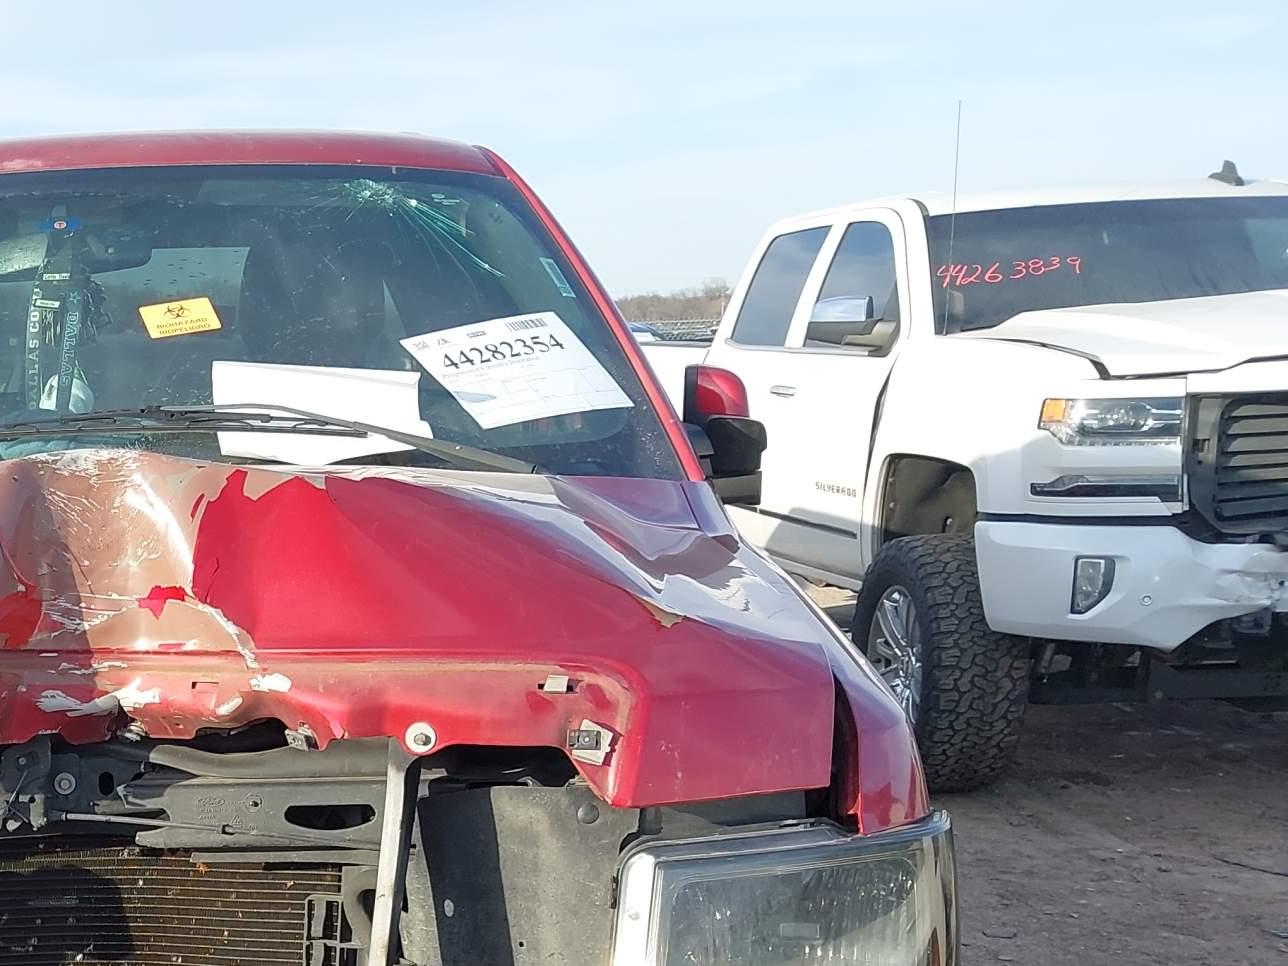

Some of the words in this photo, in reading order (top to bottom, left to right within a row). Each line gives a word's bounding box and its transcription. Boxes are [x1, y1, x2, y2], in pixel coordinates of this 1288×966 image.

[156, 317, 208, 330] BIOHAZARD
[159, 323, 211, 336] BIOPELIGRO
[59, 311, 79, 386] DALLAS
[443, 333, 566, 370] 44282354
[815, 481, 857, 498] SILVERADO
